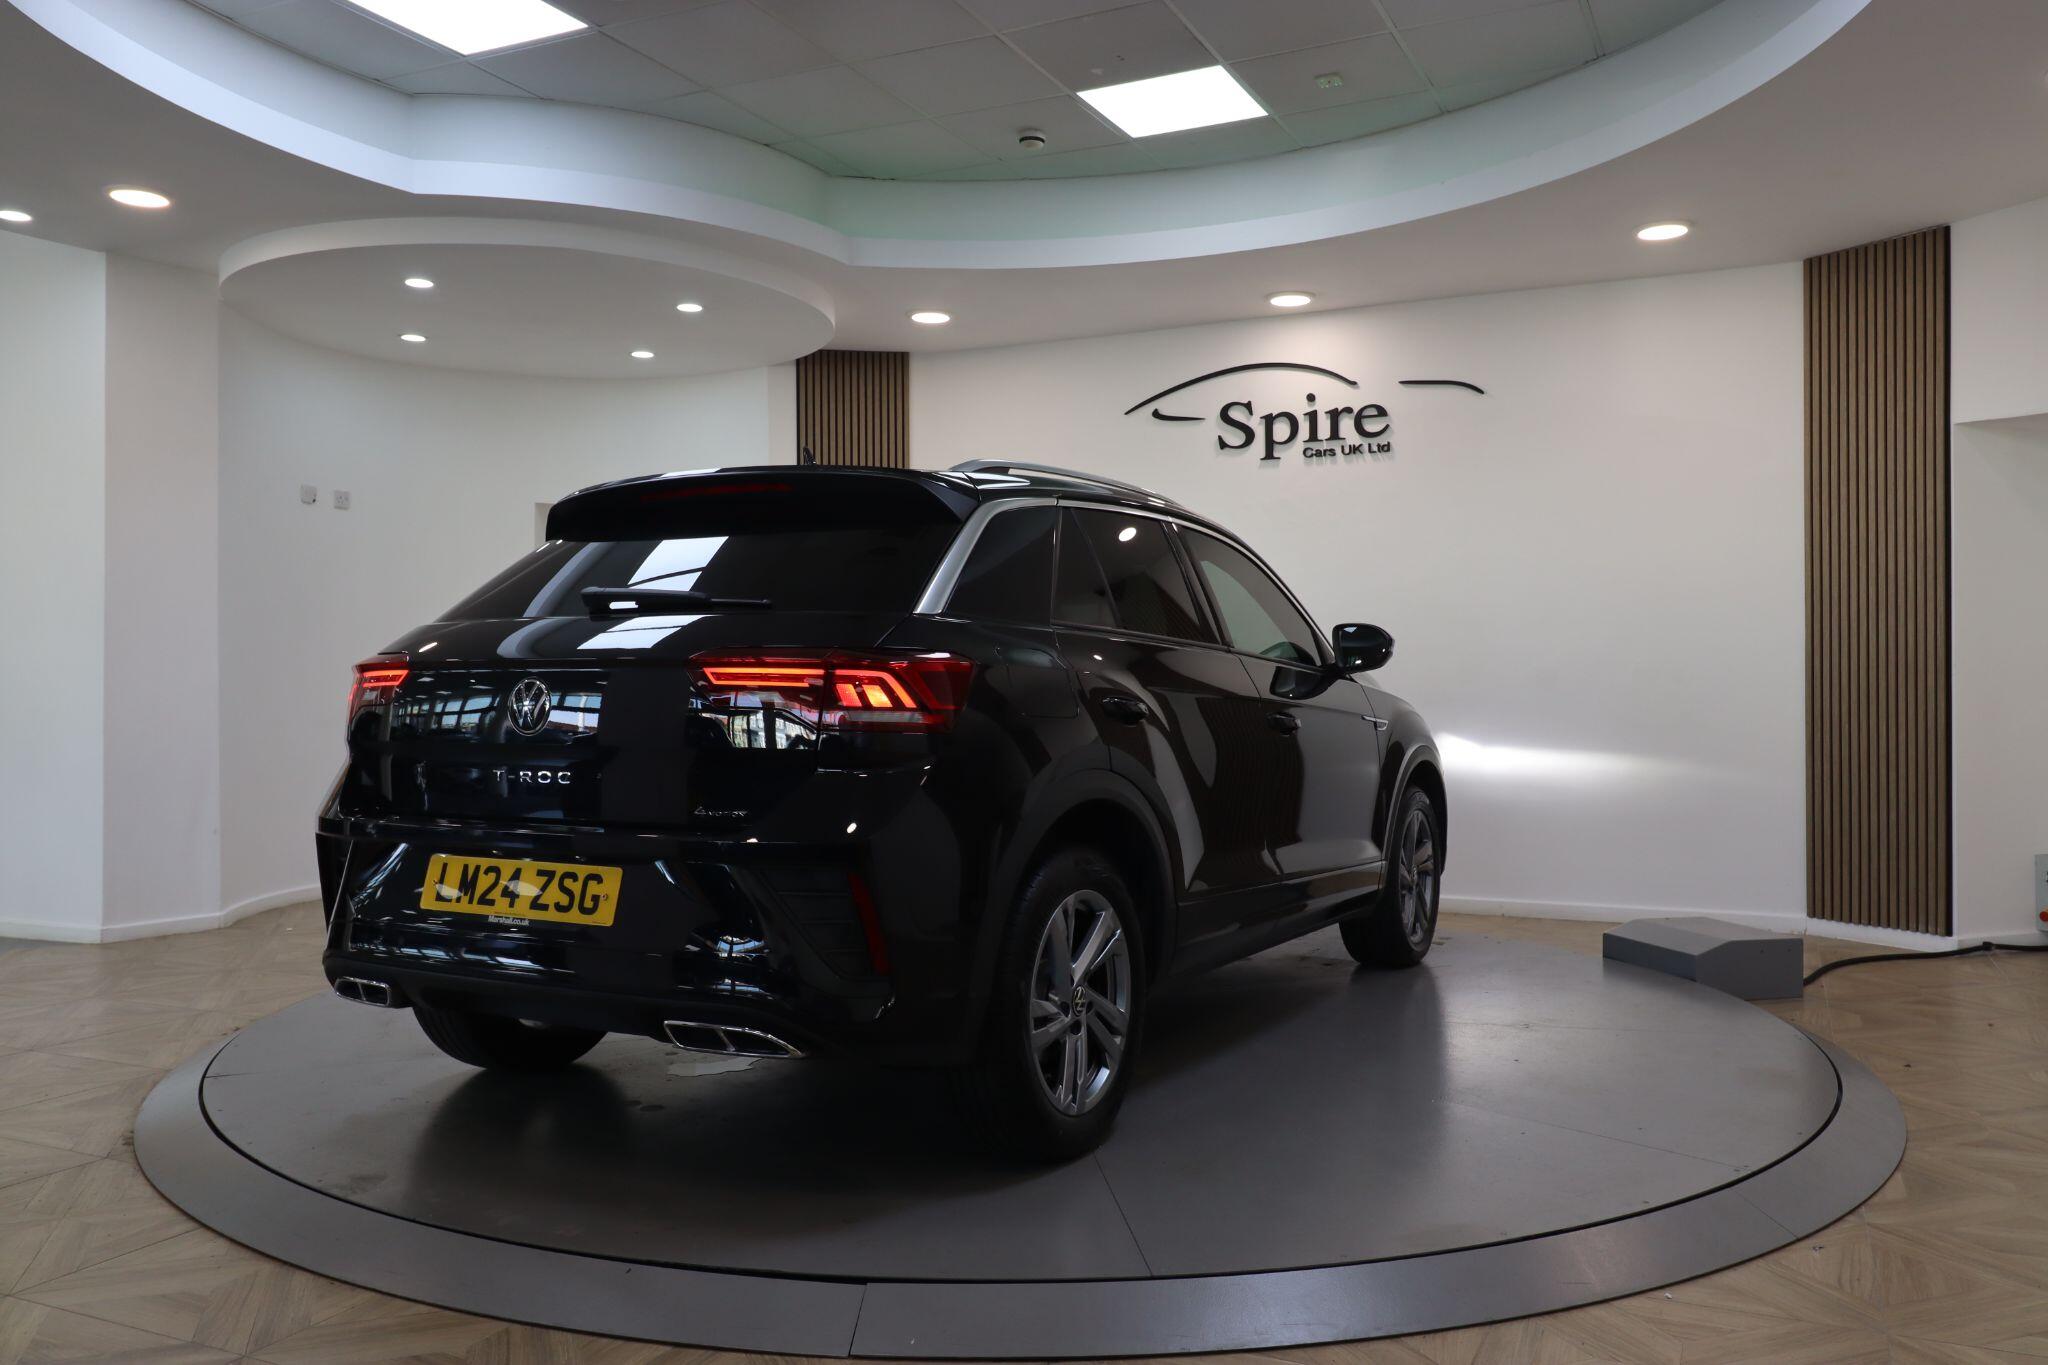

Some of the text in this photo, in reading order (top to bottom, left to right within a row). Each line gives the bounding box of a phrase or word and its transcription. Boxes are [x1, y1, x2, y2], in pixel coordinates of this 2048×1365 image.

[1217, 392, 1390, 460] Spire
[1302, 441, 1391, 458] Cars UK Ltd
[492, 769, 571, 784] T-ROC
[434, 861, 604, 916] LM24 ZSG
